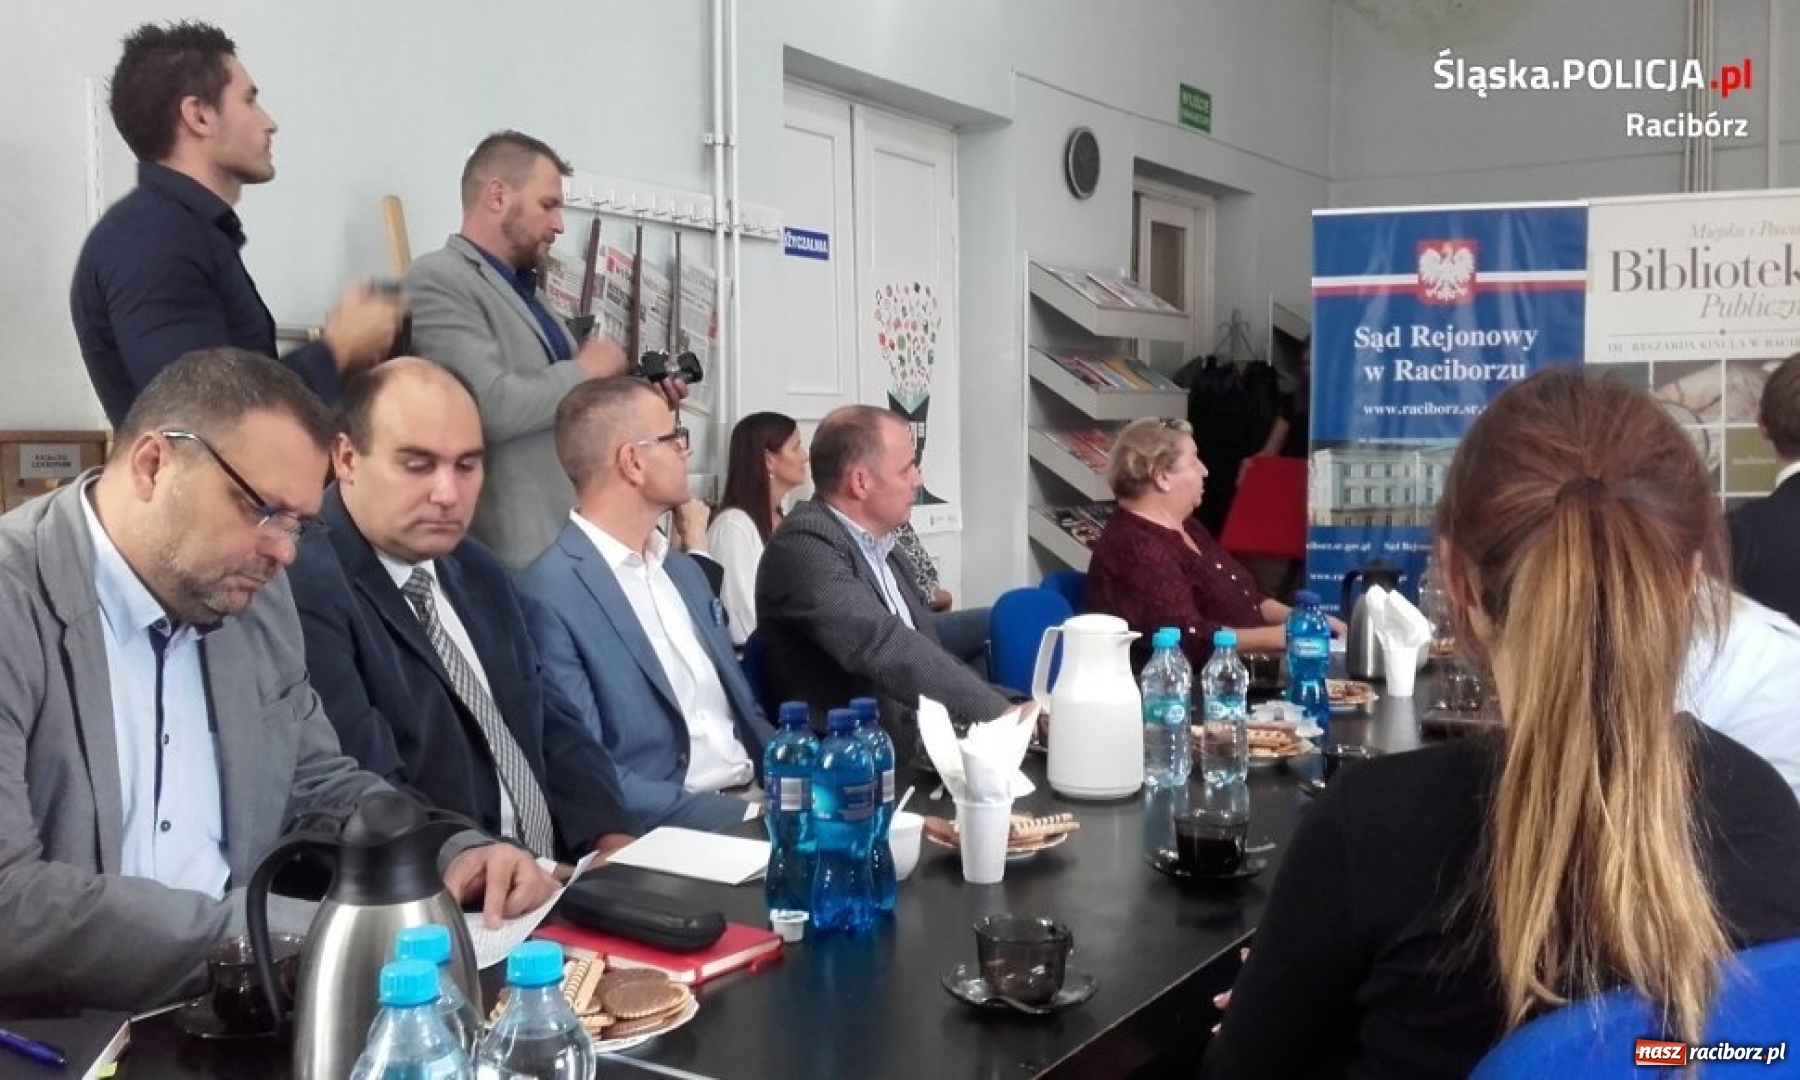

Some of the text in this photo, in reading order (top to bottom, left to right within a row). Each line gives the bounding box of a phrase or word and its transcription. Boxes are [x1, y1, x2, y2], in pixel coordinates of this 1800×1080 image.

[1354, 324, 1538, 352] Sąd Rejonowy
[1364, 359, 1528, 382] w Raciborzu
